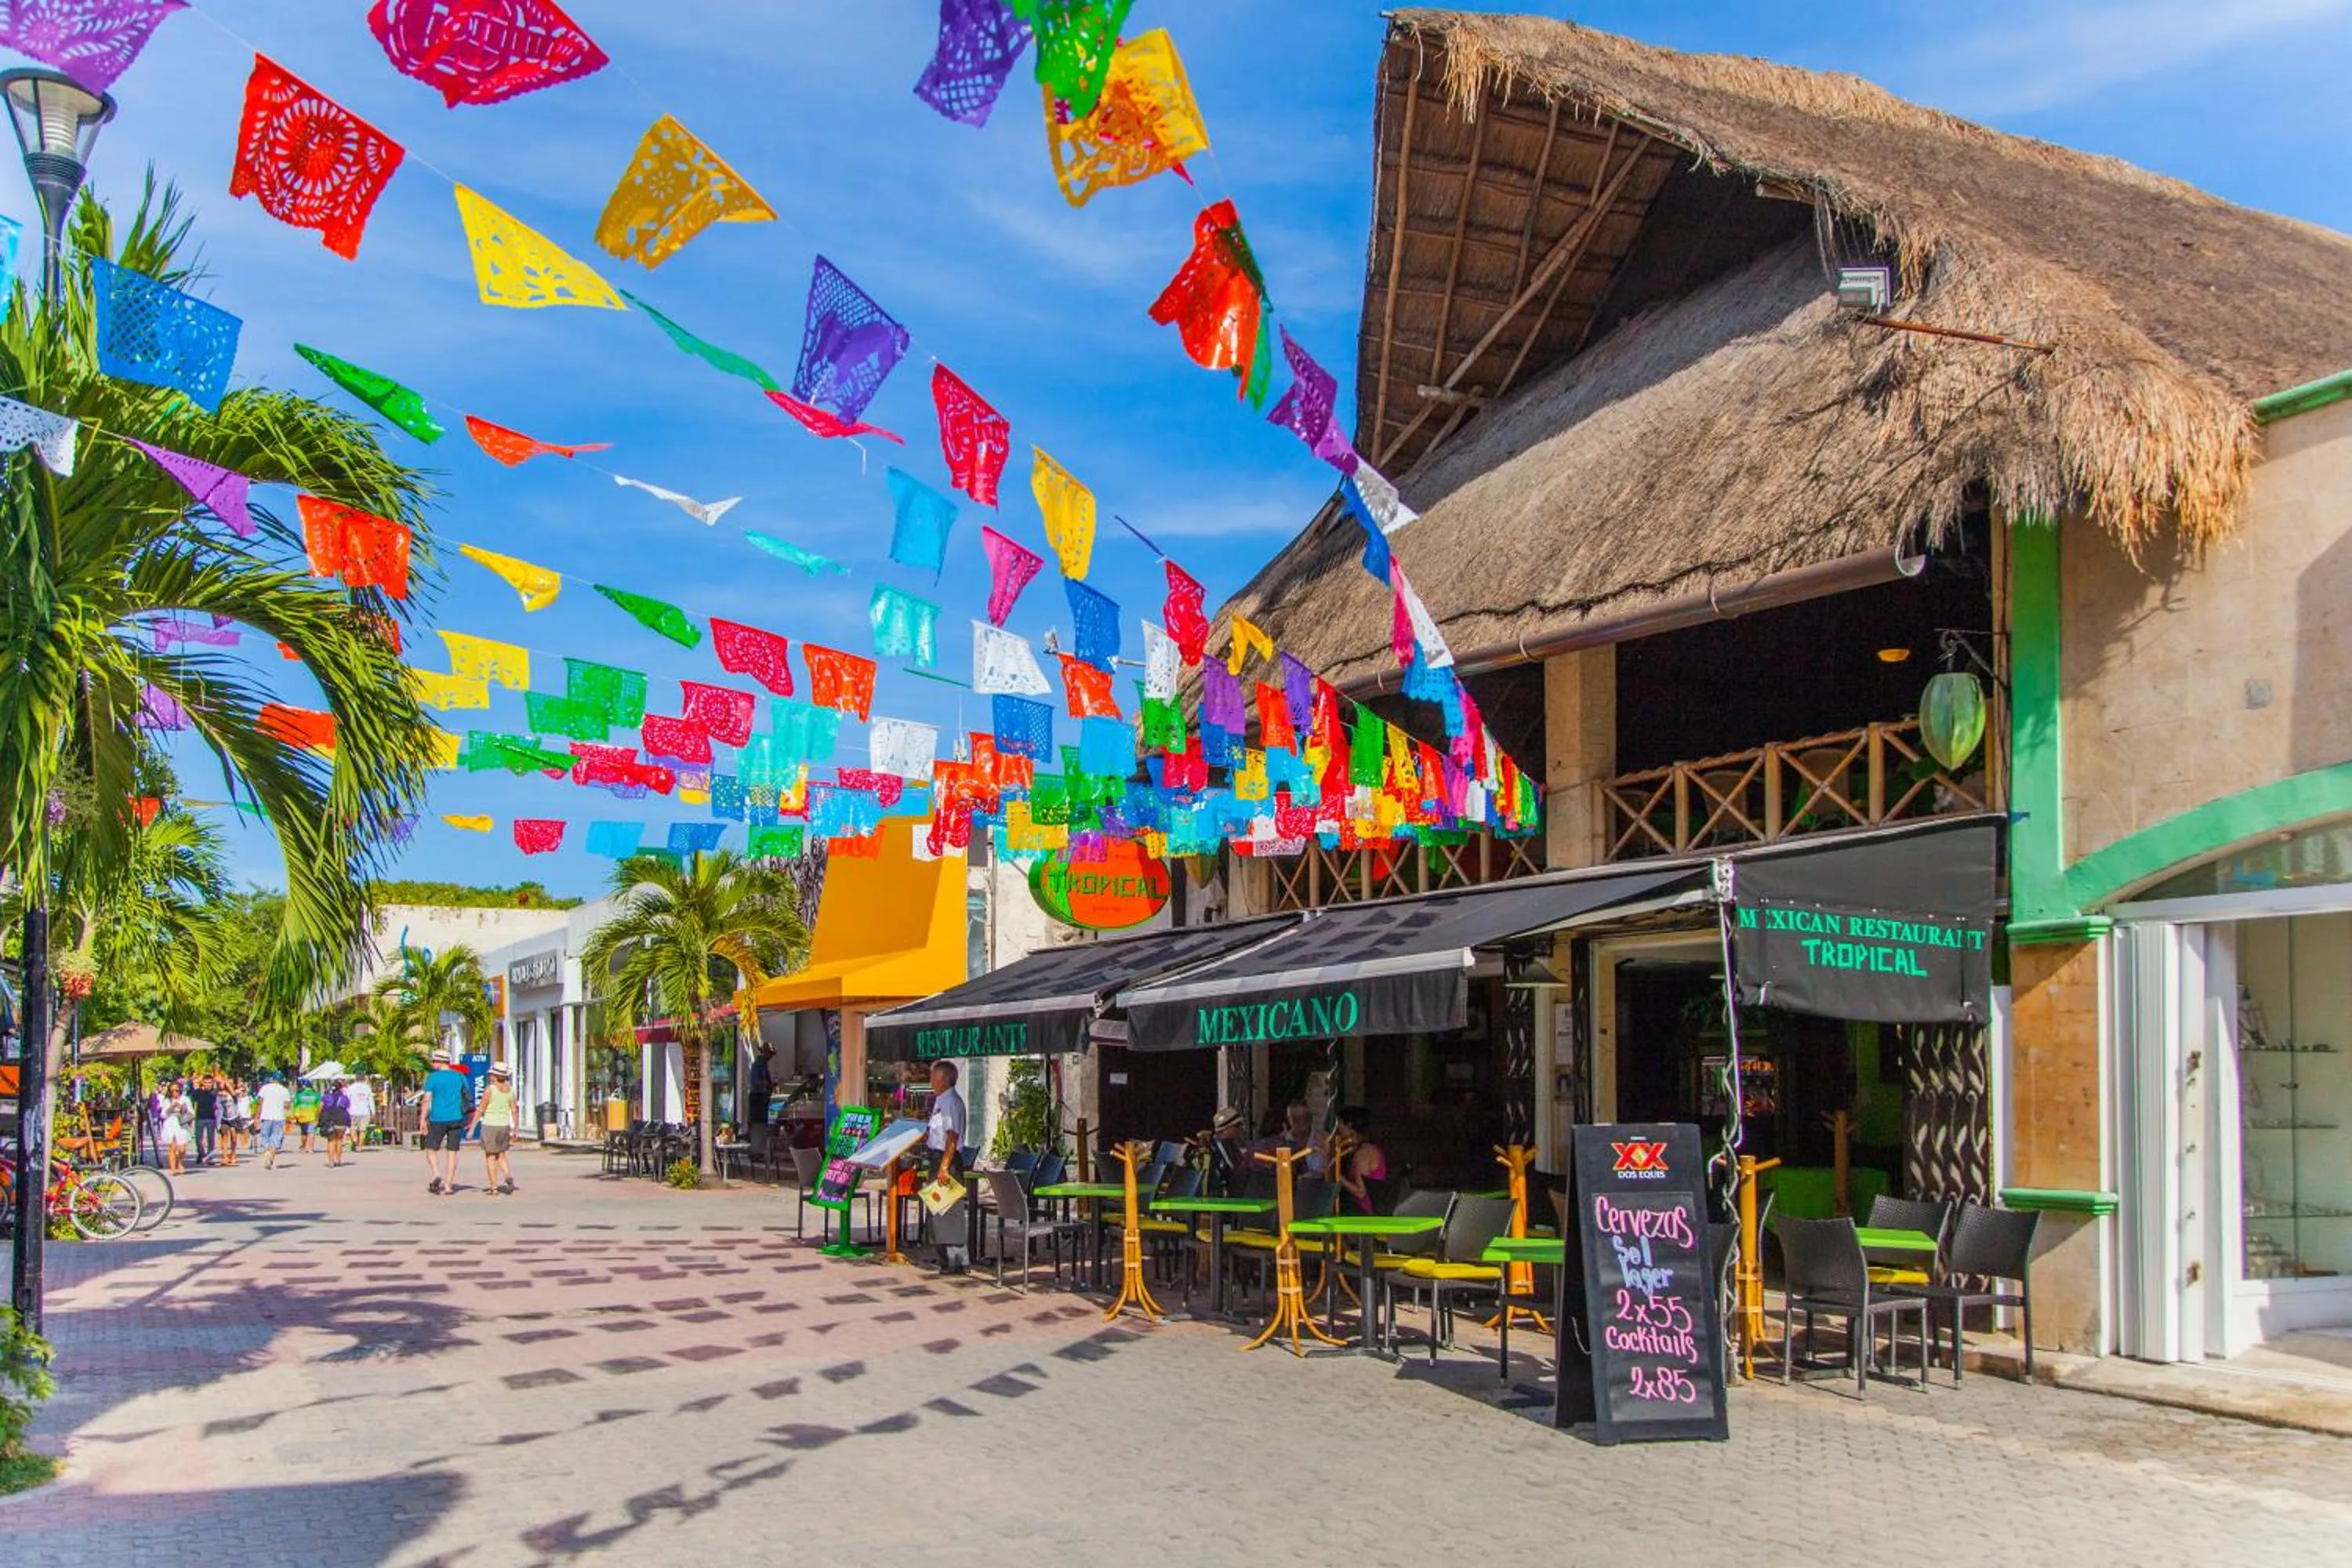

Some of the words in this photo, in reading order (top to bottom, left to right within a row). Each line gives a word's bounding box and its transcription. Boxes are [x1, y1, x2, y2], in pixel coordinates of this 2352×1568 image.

[1047, 871, 1170, 899] TROPICAL
[1800, 938, 1928, 977] TROPICAL
[1197, 991, 1359, 1044] MEXICANO
[1617, 1171, 1637, 1179] DOS
[1595, 1195, 1694, 1249] Cervezas
[1605, 1326, 1698, 1364] Cocktails
